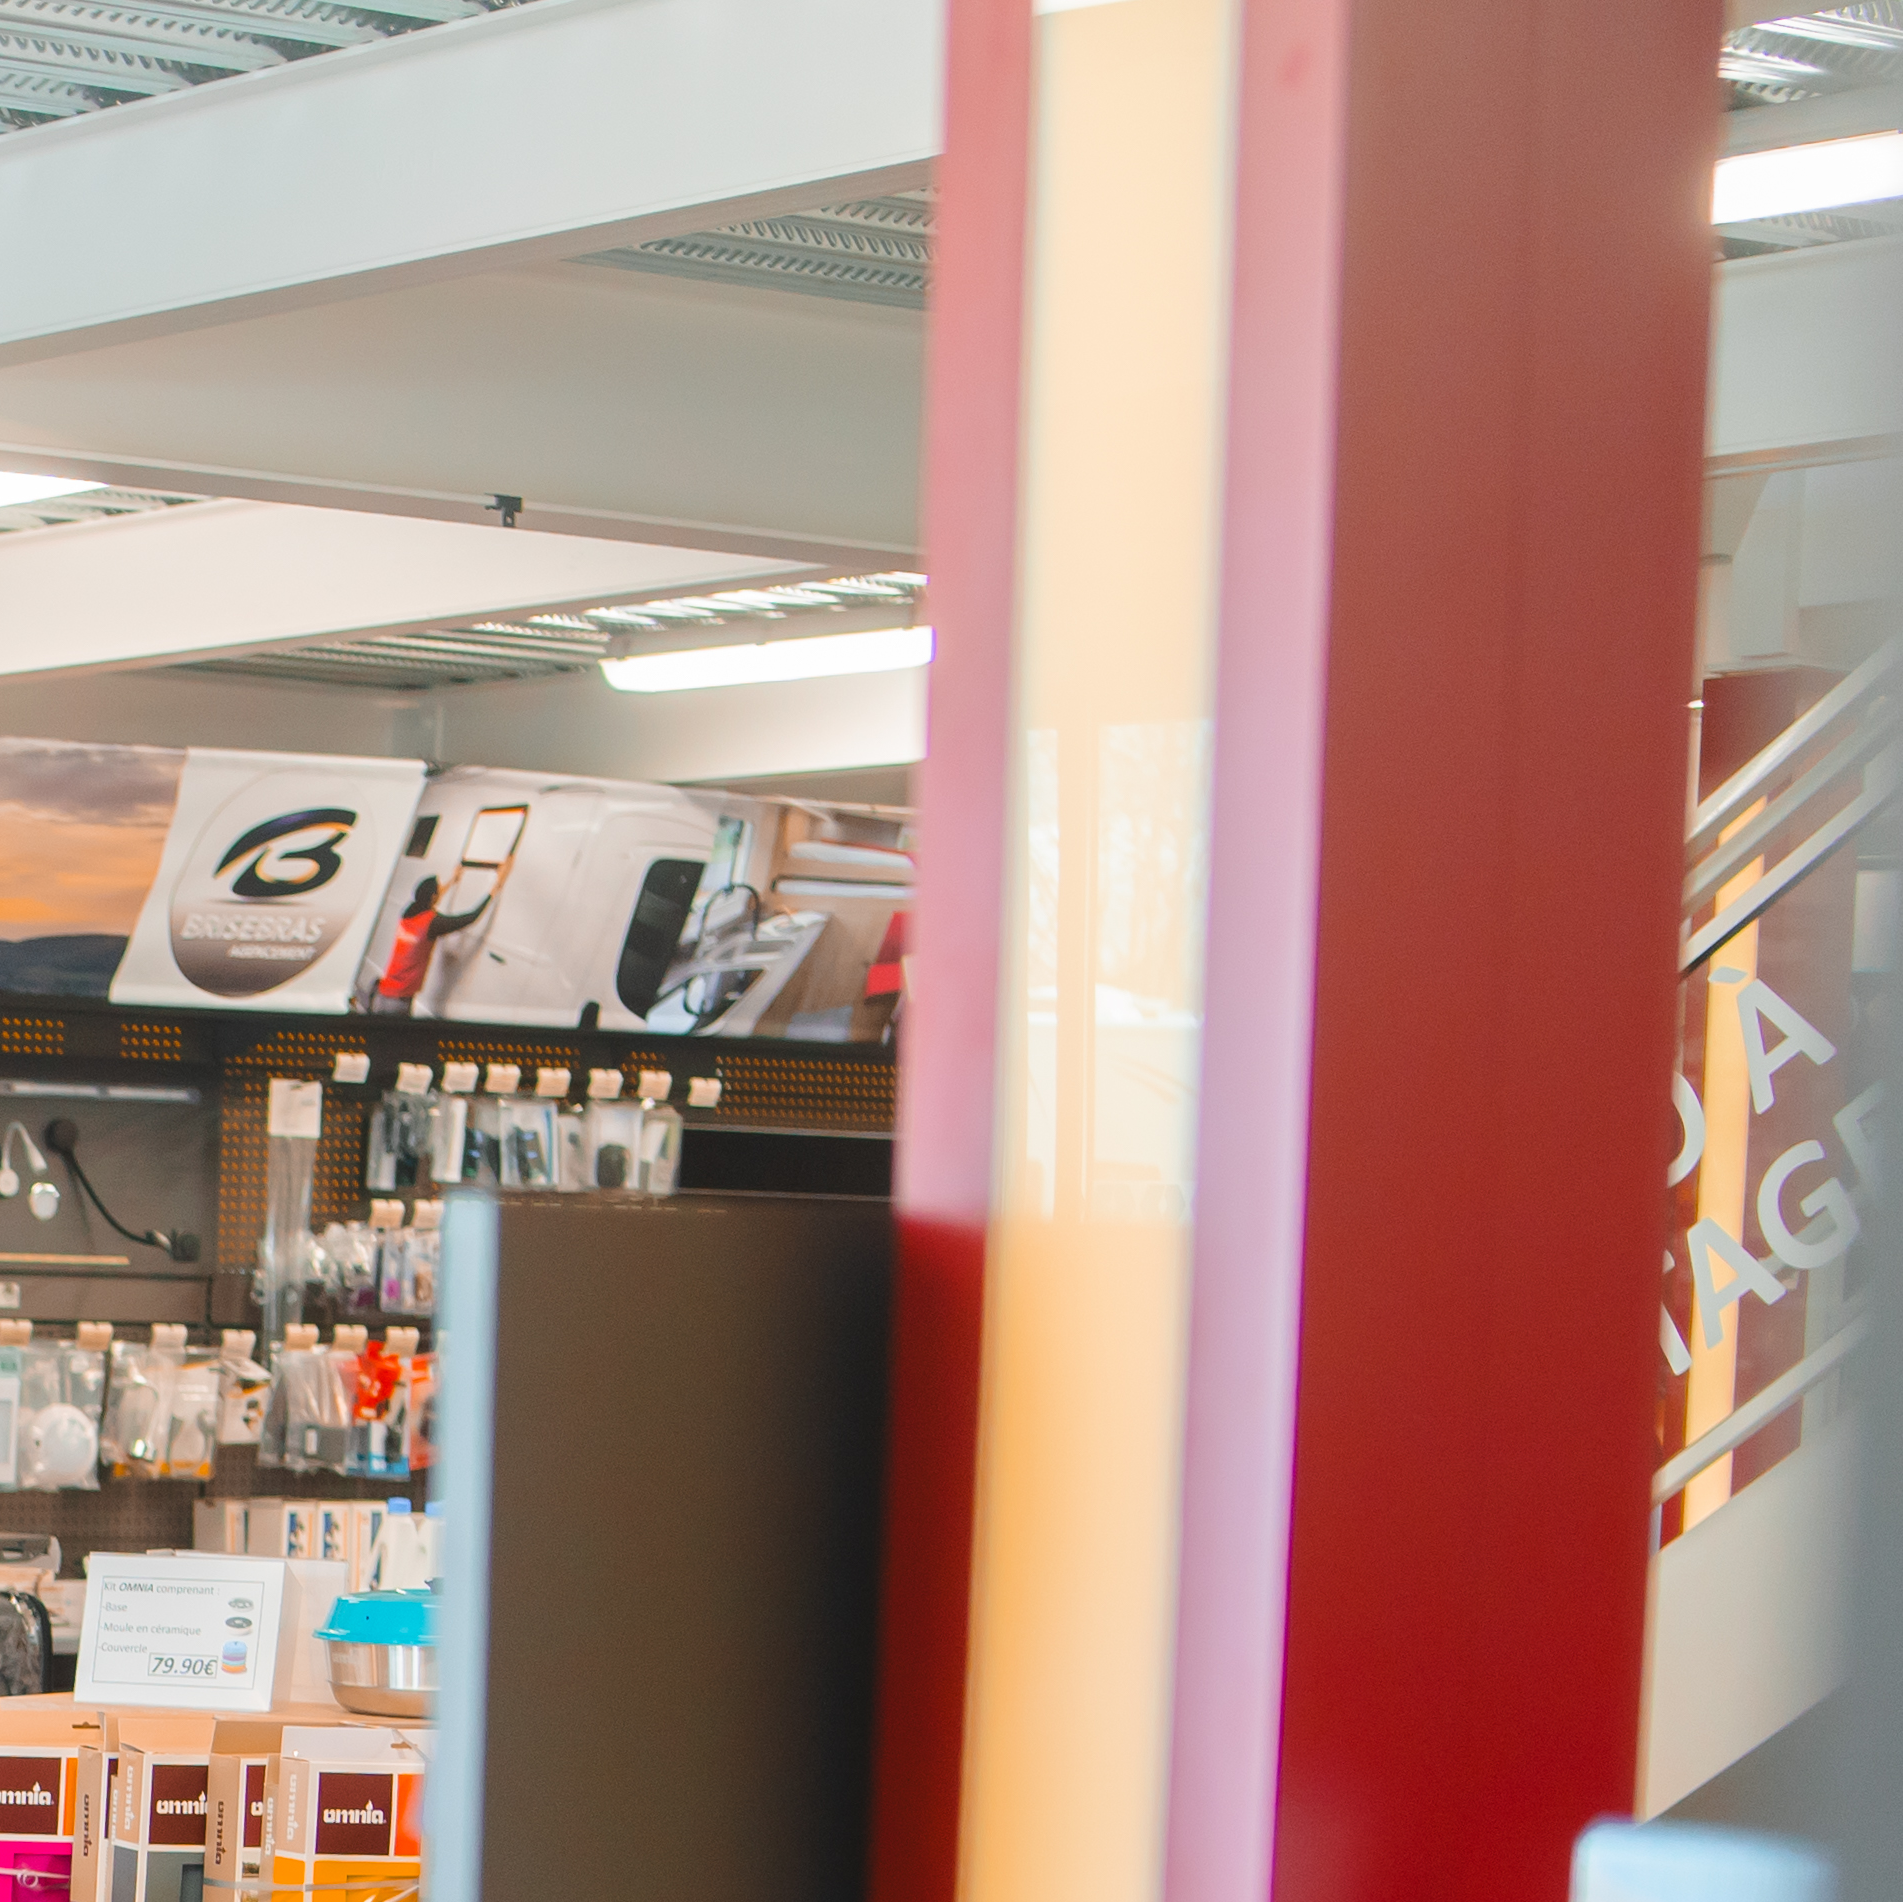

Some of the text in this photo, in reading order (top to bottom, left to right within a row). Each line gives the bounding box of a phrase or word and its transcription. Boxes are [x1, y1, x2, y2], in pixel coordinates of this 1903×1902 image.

[178, 914, 324, 944] BRISEBRAS
[103, 1581, 214, 1597] Kit OMNIA comprenant
[135, 1624, 202, 1637] en céramique
[151, 1656, 218, 1677] 79.90€
[322, 1799, 385, 1825] omnia
